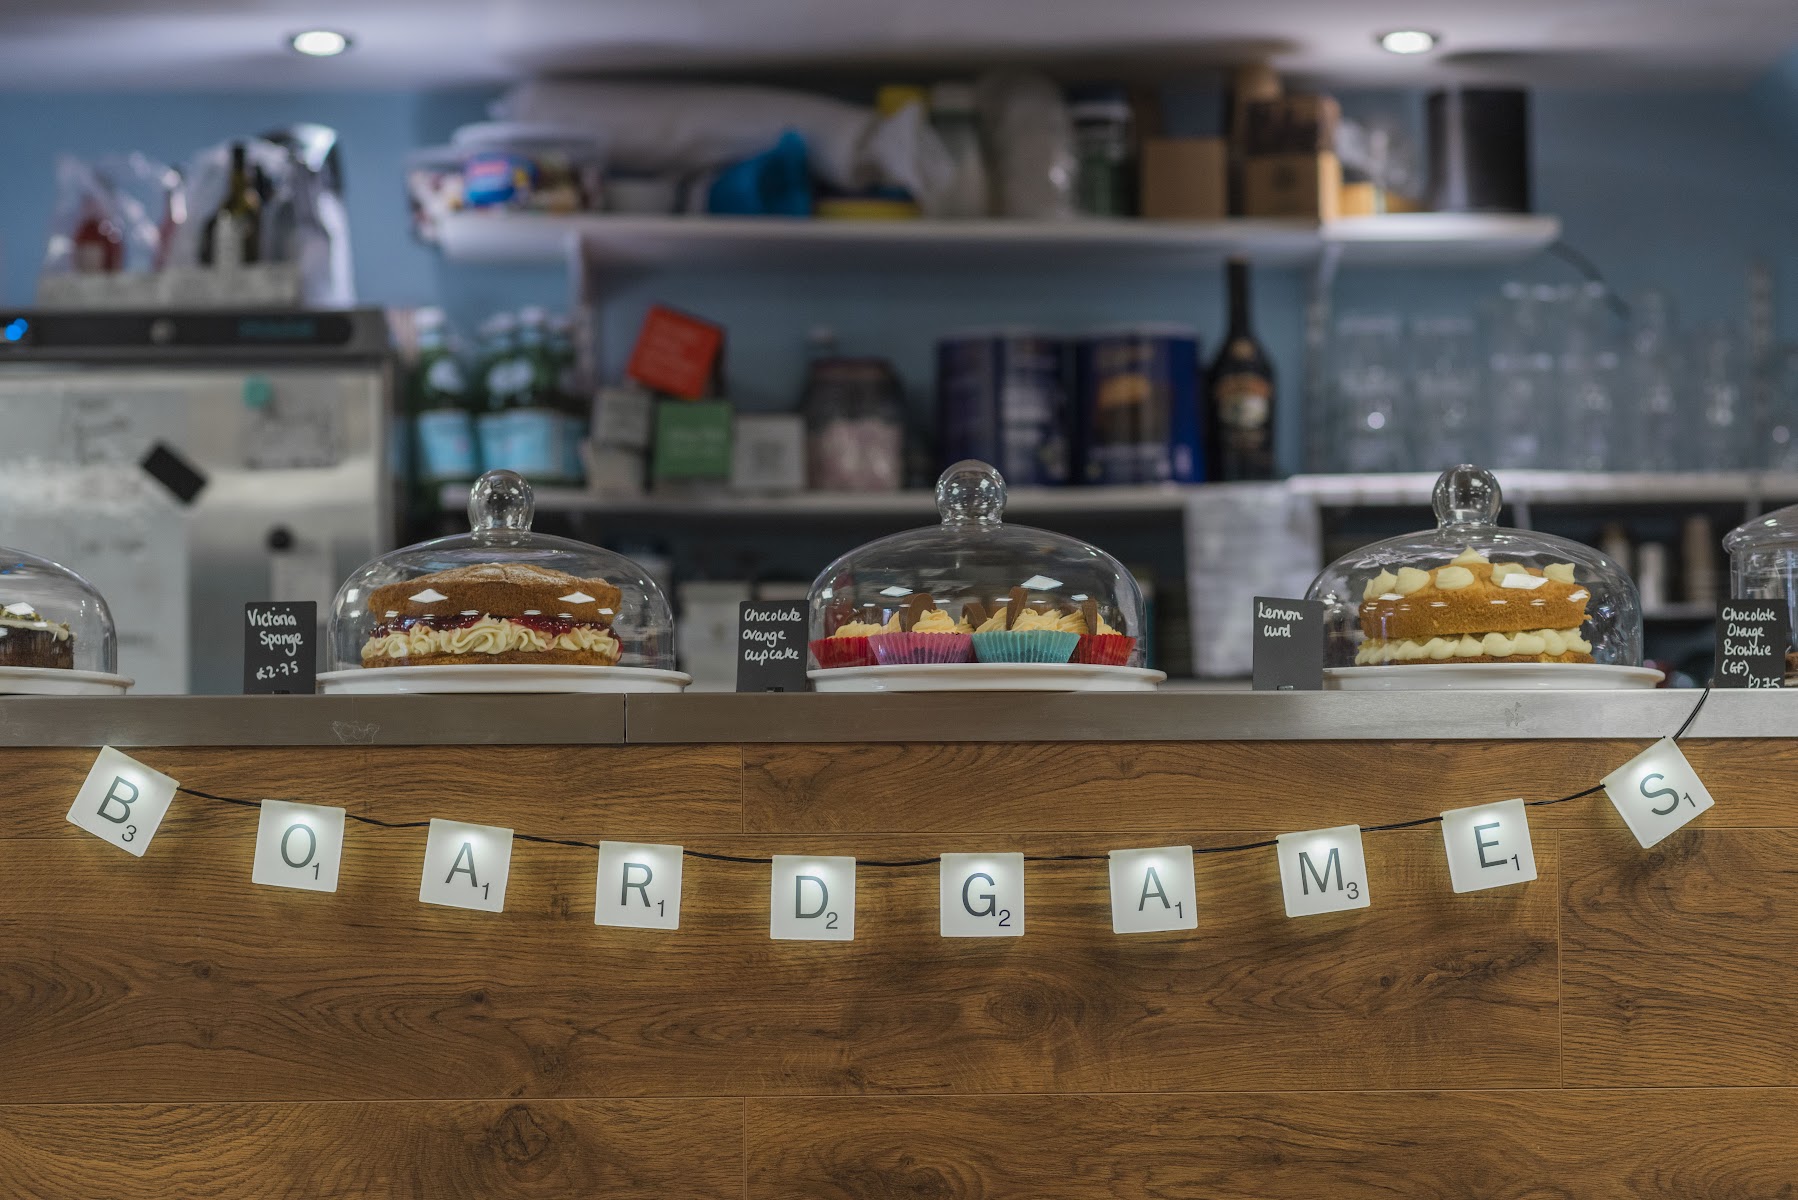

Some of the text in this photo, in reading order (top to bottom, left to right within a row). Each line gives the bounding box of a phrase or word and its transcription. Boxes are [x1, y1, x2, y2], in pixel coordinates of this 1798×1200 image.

[247, 606, 297, 627] Victoria
[744, 607, 802, 622] Chocolate
[1258, 601, 1304, 621] Lemon
[1722, 606, 1777, 621] Chocolate
[259, 630, 304, 657] Sponge
[1723, 638, 1772, 657] Brownie
[256, 660, 299, 680] £2.75
[1721, 659, 1750, 677] (GF)
